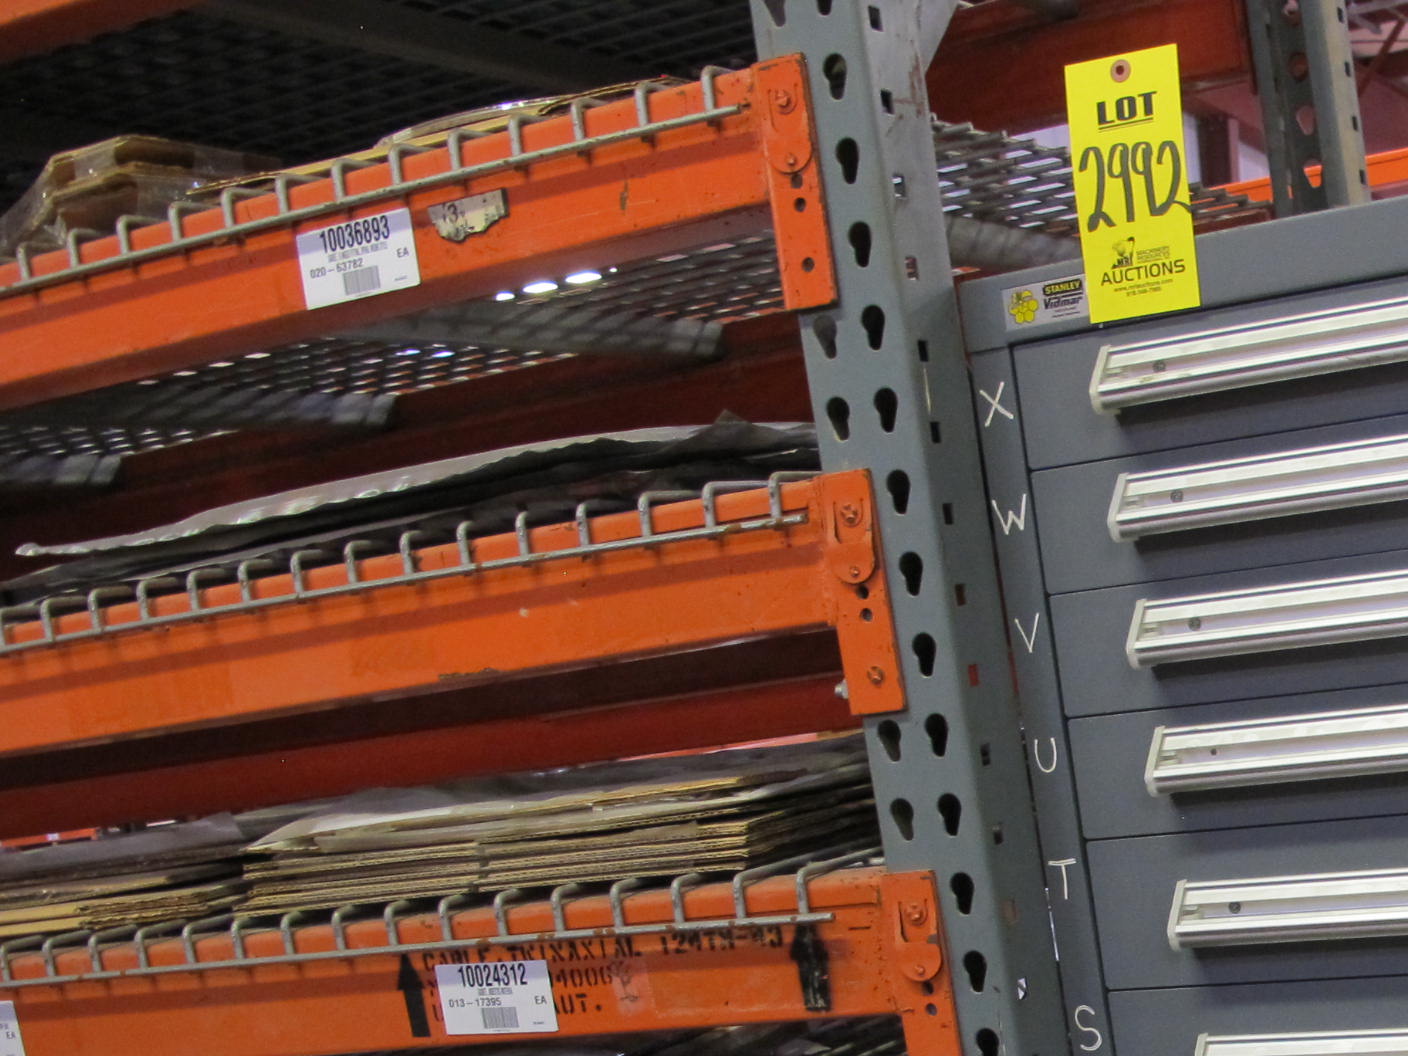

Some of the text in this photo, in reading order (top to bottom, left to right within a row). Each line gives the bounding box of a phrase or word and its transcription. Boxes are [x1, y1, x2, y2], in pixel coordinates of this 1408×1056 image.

[1096, 91, 1157, 125] LOT
[1078, 140, 1192, 232] 2992
[319, 215, 391, 253] 10036893
[396, 248, 409, 258] EA
[1044, 281, 1081, 294] STANLEY
[1101, 258, 1186, 287] AUCTIONS
[1043, 297, 1083, 310] Vidmar
[979, 381, 1014, 427] X
[992, 494, 1026, 535] W
[1014, 613, 1039, 653] V
[1034, 738, 1057, 773] U
[1048, 857, 1077, 900] T
[458, 962, 528, 989] 10024312
[534, 995, 548, 1005] EA
[1074, 1005, 1102, 1051] S
